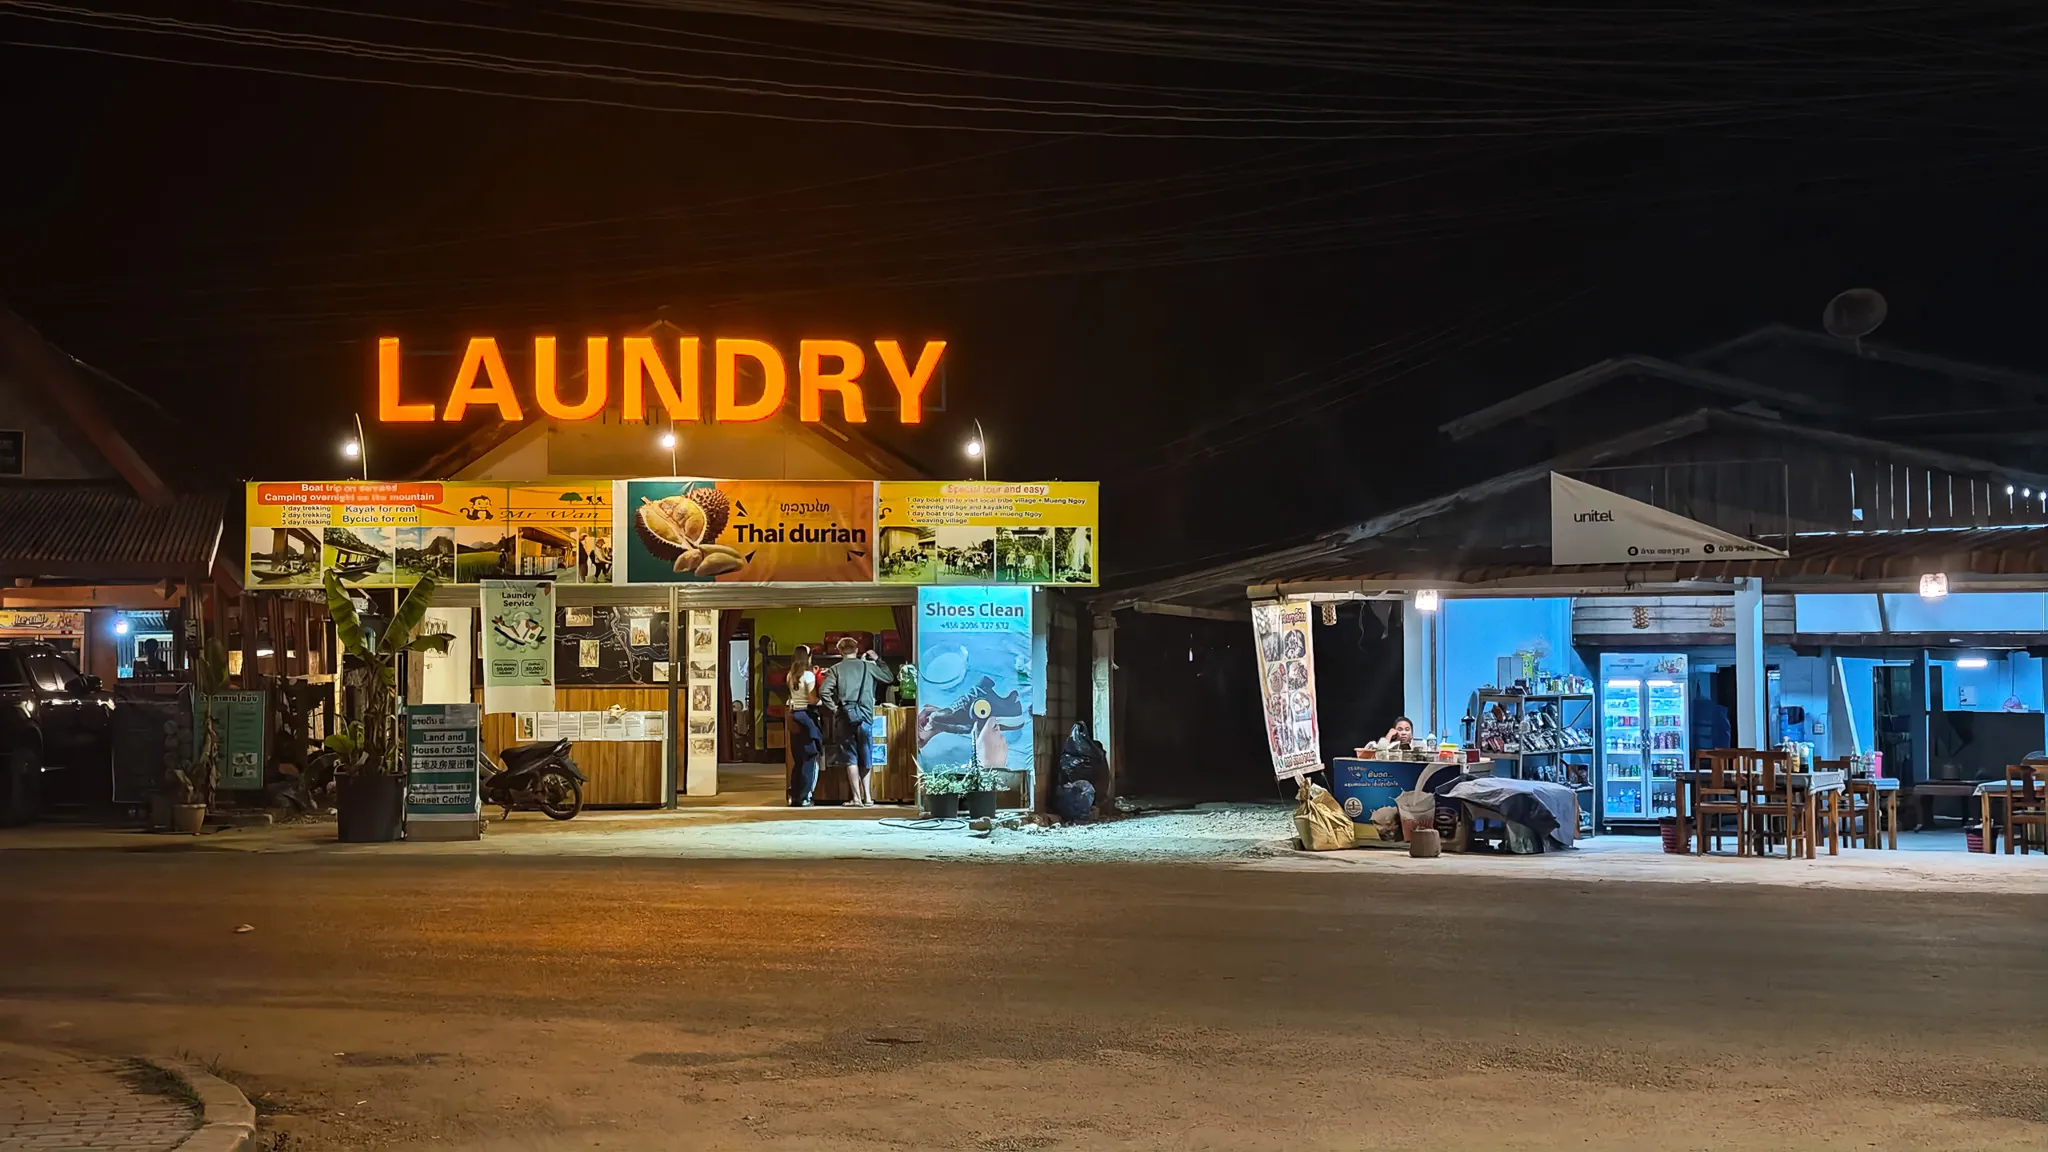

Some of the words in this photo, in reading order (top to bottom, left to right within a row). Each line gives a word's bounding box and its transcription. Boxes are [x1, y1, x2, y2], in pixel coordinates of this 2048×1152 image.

[378, 336, 948, 424] LAUNDRY
[301, 484, 323, 492] Boat
[326, 484, 342, 493] trip
[948, 484, 980, 494] Special
[1004, 485, 1021, 493] and
[1024, 486, 1045, 494] easy
[265, 493, 307, 502] Camping
[345, 506, 376, 514] Kayak
[499, 510, 536, 519] Mr
[546, 509, 600, 519] Wan
[342, 515, 378, 524] Bycicle
[1574, 509, 1615, 522] unitel
[733, 522, 784, 542] Thai
[789, 522, 866, 542] durian
[502, 592, 537, 600] Laundry
[925, 602, 976, 617] Shoes
[979, 602, 1024, 617] Clean
[424, 733, 445, 741] Land
[448, 733, 464, 741] and
[412, 745, 440, 754] House
[442, 745, 454, 754] for
[456, 745, 475, 754] Sale
[409, 795, 440, 804] Sunset
[442, 796, 470, 804] Coffee
